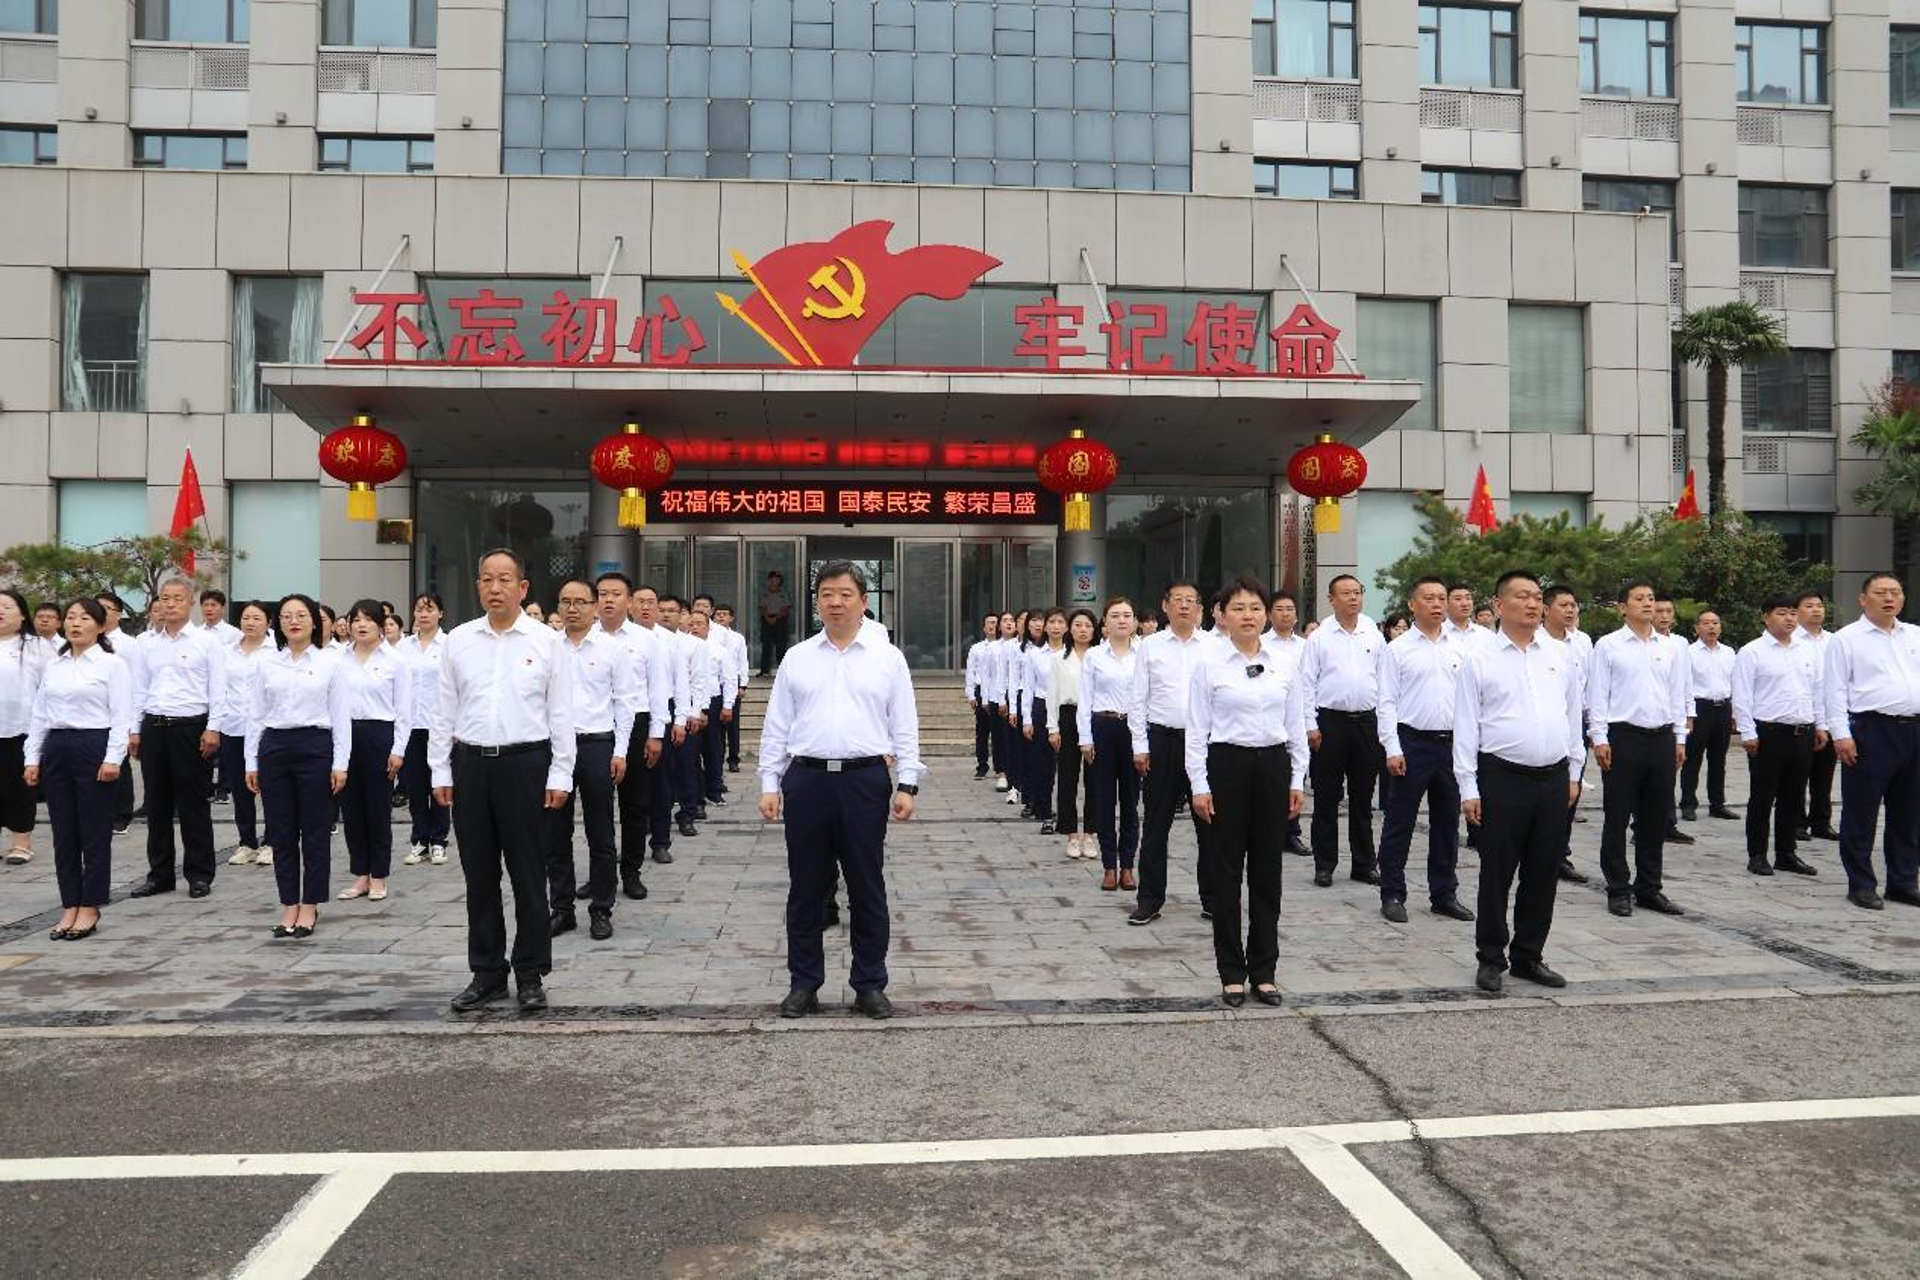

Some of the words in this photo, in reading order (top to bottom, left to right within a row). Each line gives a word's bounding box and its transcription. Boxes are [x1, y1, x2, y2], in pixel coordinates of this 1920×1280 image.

[350, 289, 706, 365] 不忘初心
[1013, 296, 1341, 375] 牢记使命
[661, 490, 825, 513] 祝福伟大的祖国
[838, 490, 931, 513] 国泰民安
[943, 491, 1036, 515] 繁荣昌盛
